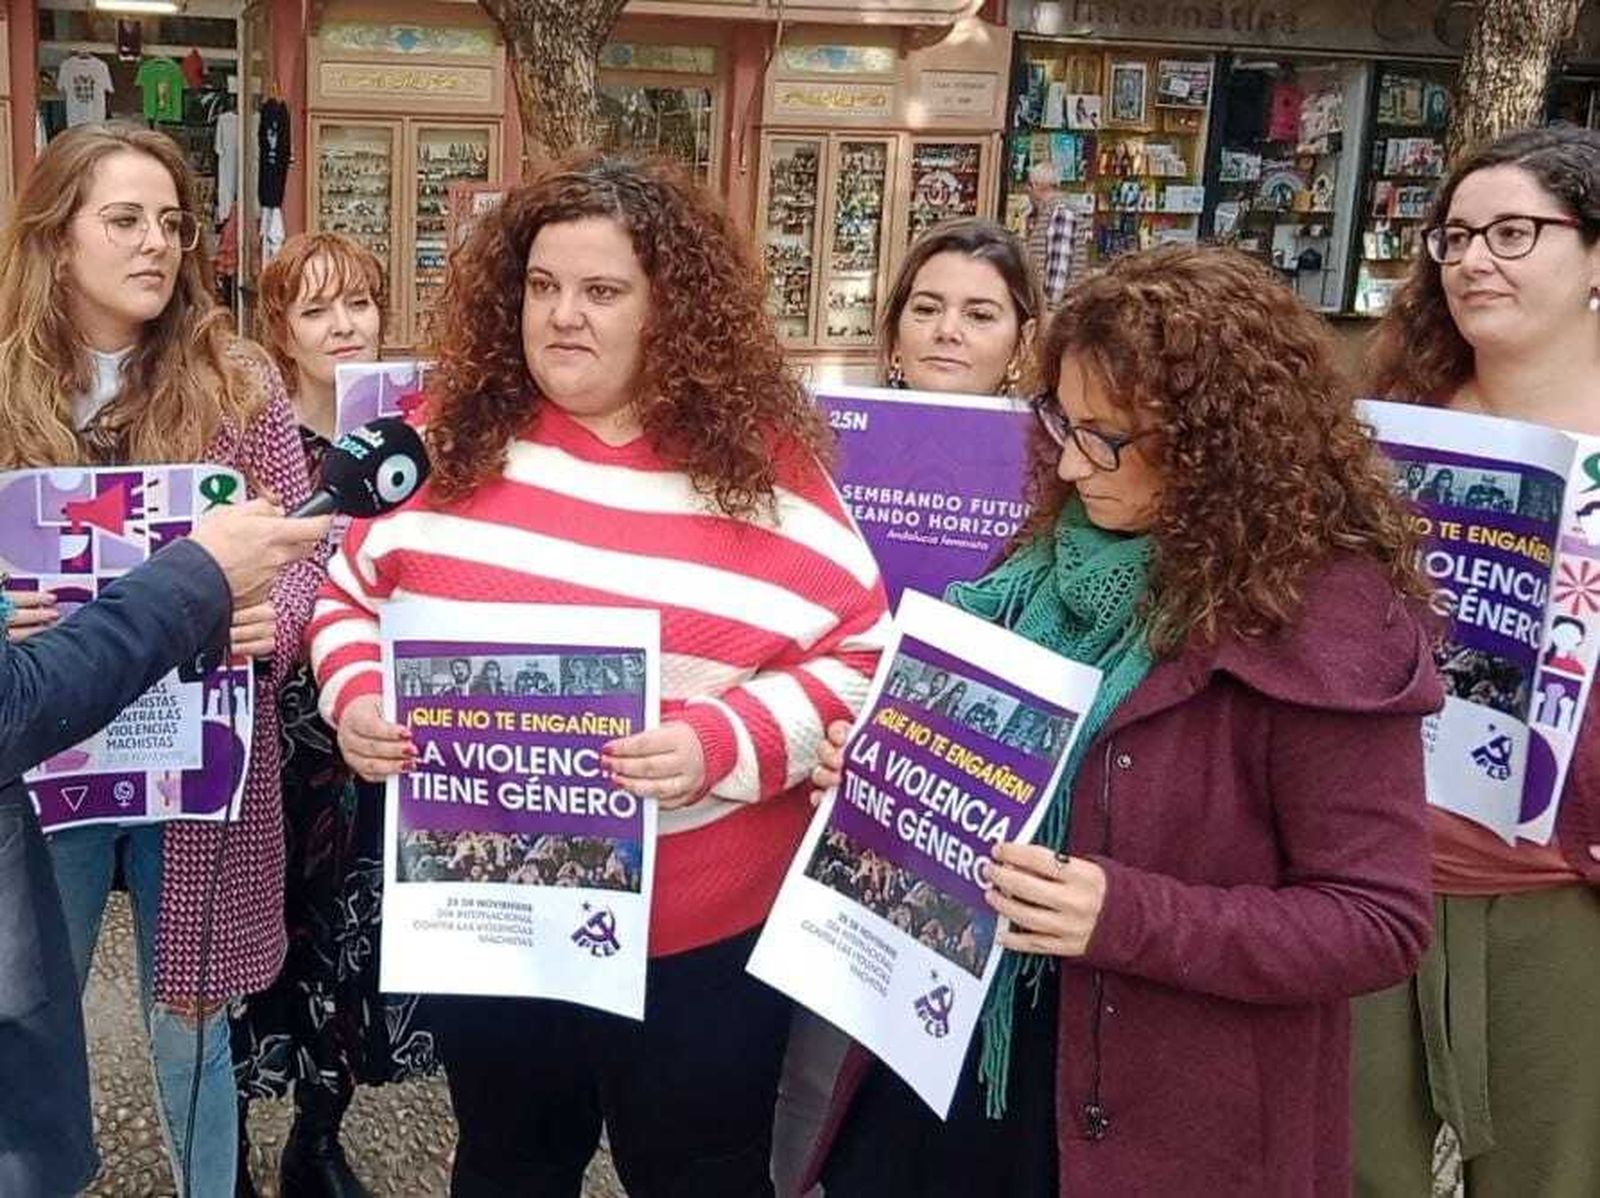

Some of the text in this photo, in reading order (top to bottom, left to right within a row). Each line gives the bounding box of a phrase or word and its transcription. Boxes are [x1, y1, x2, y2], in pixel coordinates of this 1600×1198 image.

[829, 410, 868, 431] 25N
[841, 484, 1030, 518] SEMBRANDO FUTU
[1439, 521, 1462, 541] TE
[106, 722, 179, 737] VIOLENCIAS
[407, 708, 631, 736] ¡QUE NO TE ENGAÑEN!
[106, 736, 175, 750] MACHISTAS
[417, 741, 616, 779] A VIOLENC
[904, 722, 931, 746] NO
[930, 733, 950, 757] TE
[945, 742, 1035, 805] ENGAÑEN!
[407, 772, 638, 819] TIENE GÉNERO
[845, 770, 896, 828] TIENE
[850, 734, 1011, 843] LA VIOLENCIA
